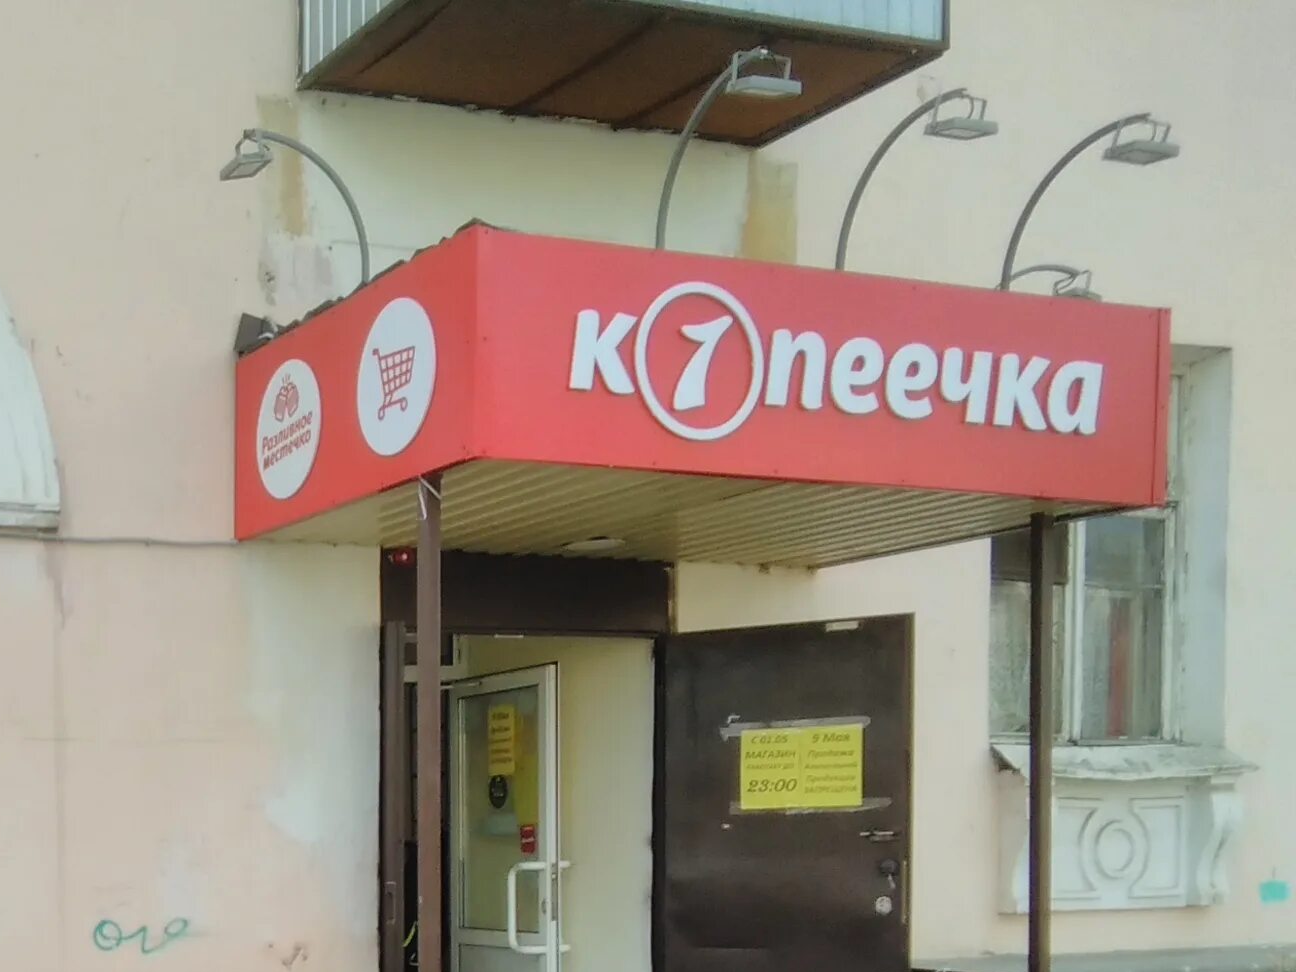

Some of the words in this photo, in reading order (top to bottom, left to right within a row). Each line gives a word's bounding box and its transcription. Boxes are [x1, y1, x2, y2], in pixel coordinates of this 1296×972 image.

[262, 410, 313, 455] Разливное
[745, 750, 796, 760] МАГАЗИН
[747, 778, 798, 793] 23:00
